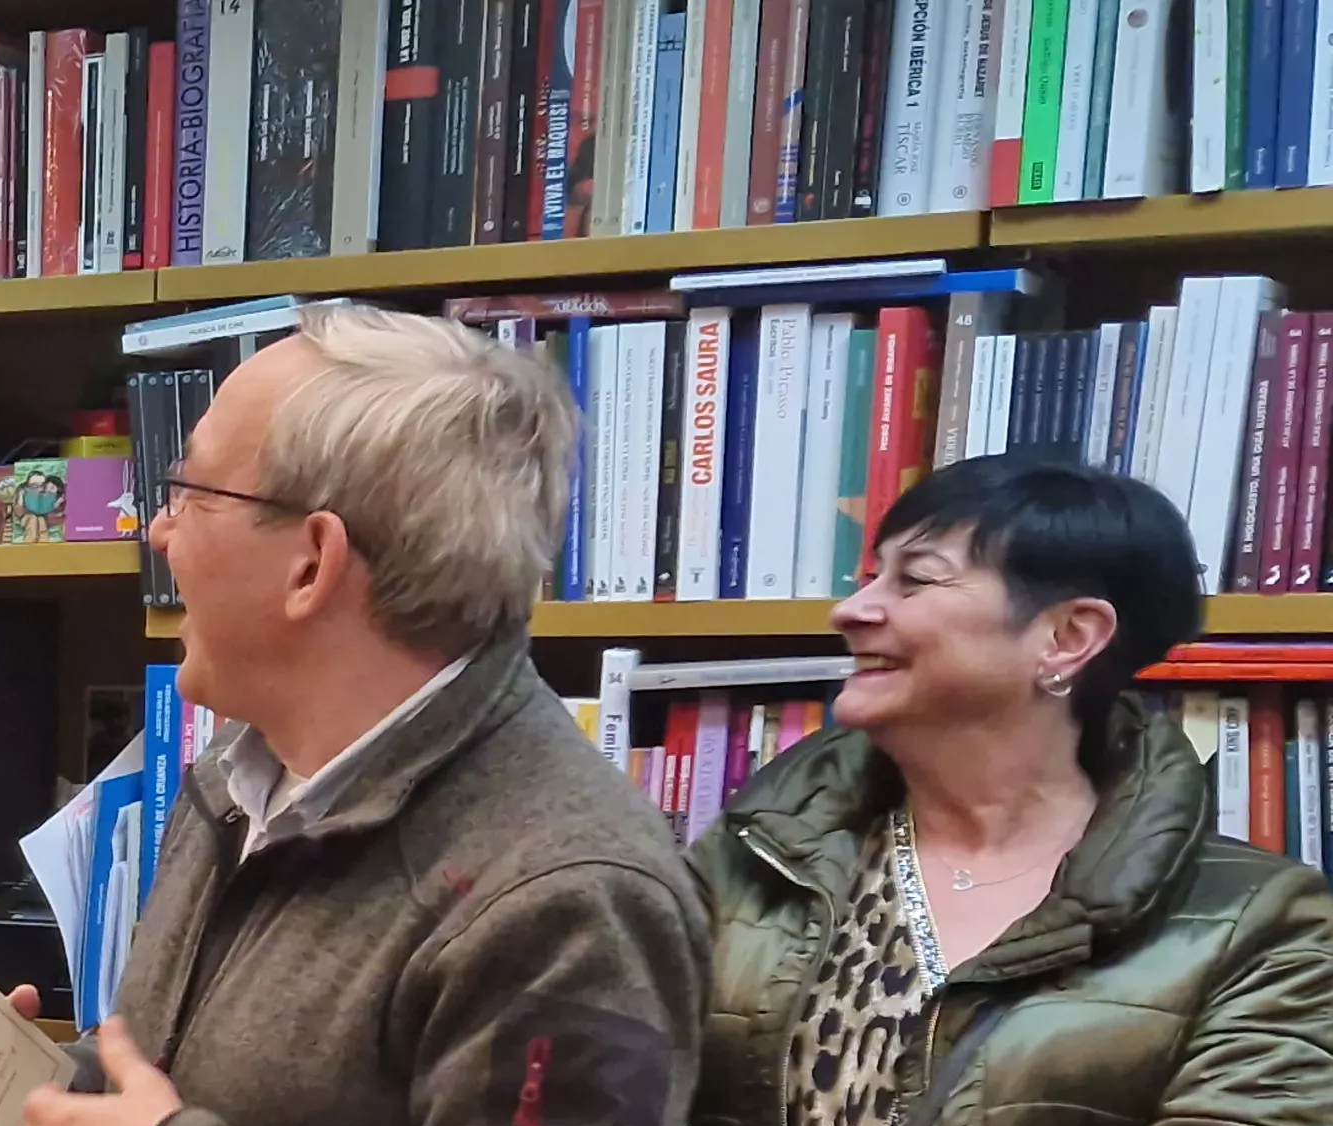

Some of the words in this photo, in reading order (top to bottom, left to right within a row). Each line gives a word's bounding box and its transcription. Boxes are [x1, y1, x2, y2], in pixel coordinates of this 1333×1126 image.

[907, 46, 927, 98] IBÉRICA
[781, 318, 798, 361] Pablo
[955, 314, 972, 326] 48
[694, 321, 720, 397] SAURA
[775, 365, 794, 419] Picasso
[690, 401, 715, 486] CARLOS
[154, 753, 167, 794] CRIANZA
